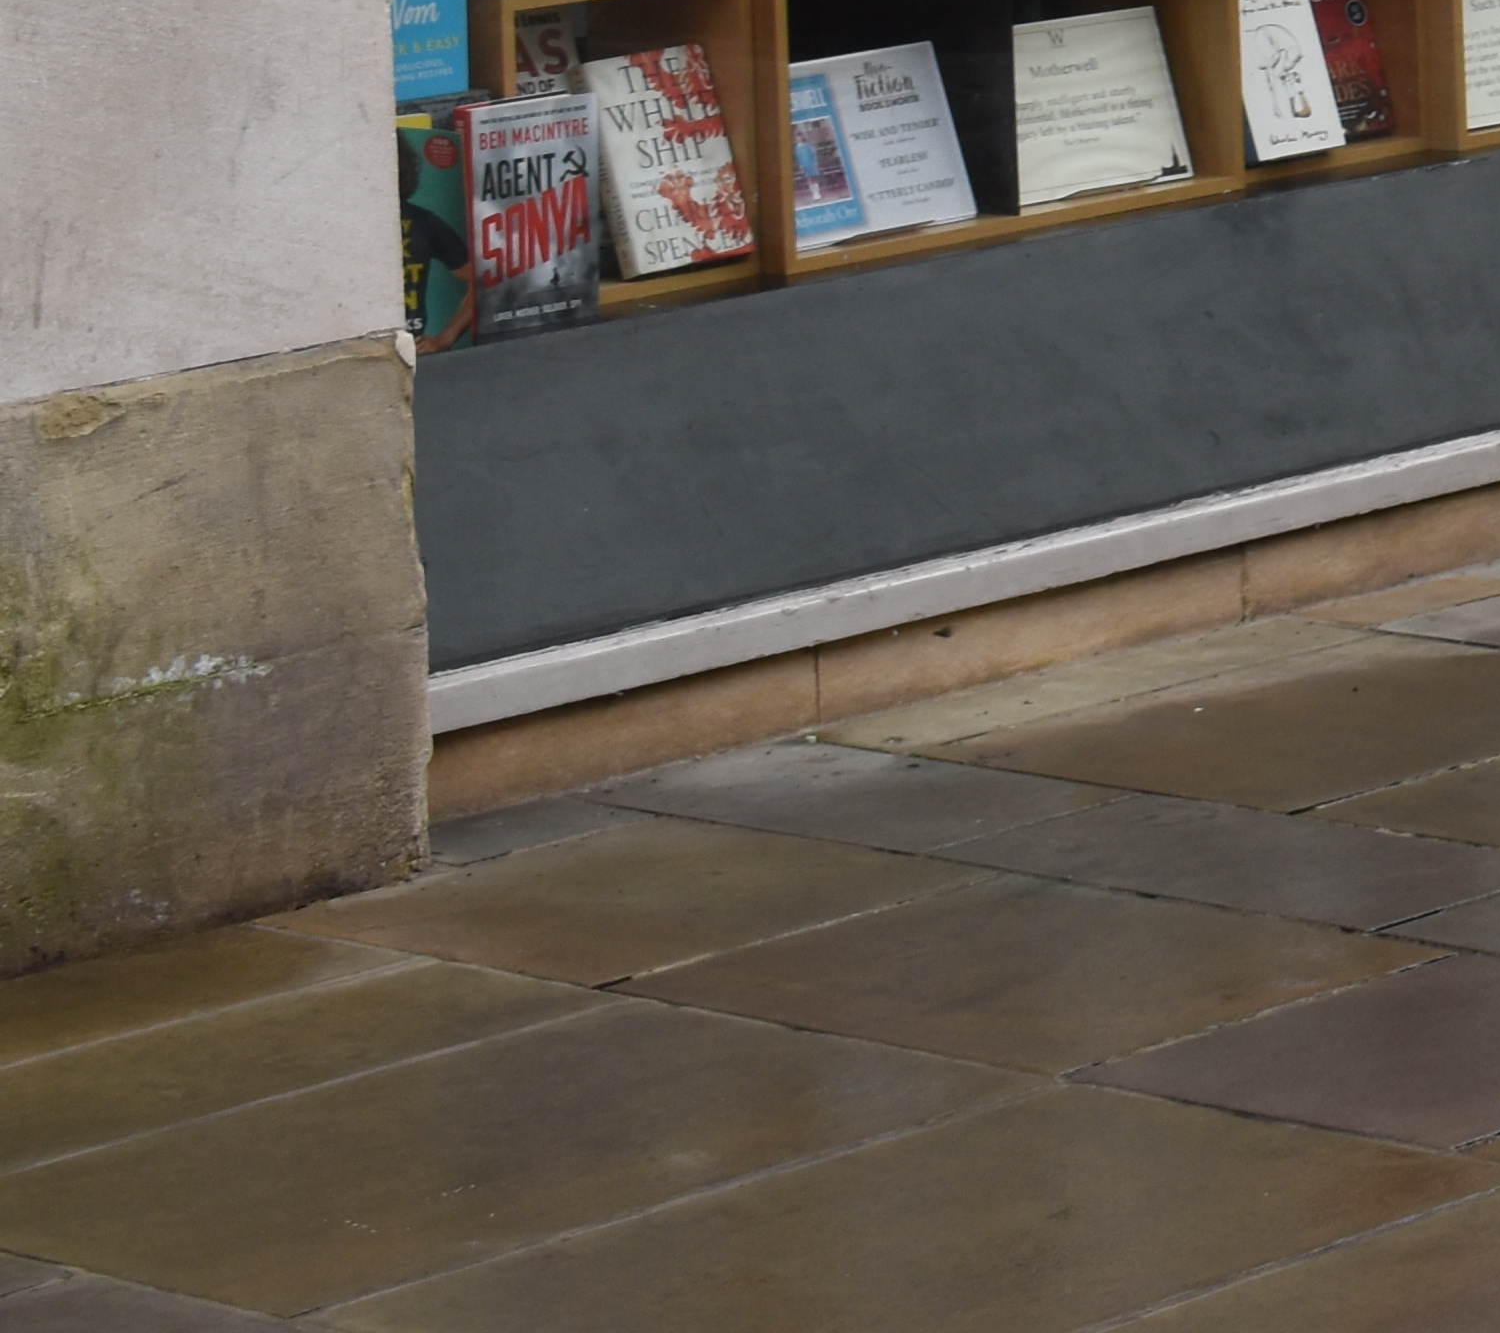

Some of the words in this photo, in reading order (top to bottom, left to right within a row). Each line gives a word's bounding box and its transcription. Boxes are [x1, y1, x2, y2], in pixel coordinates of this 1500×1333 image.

[618, 56, 680, 95] THE
[1029, 57, 1099, 79] Motherwell
[538, 78, 556, 93] OF
[853, 74, 915, 100] Fiction
[604, 96, 715, 133] WHITE
[479, 131, 507, 151] BEN
[511, 116, 590, 145] MACINTYRE
[636, 137, 708, 170] SHIP
[481, 152, 556, 202] AGENT
[481, 175, 592, 289] SONYA
[643, 232, 751, 266] SPENCER
